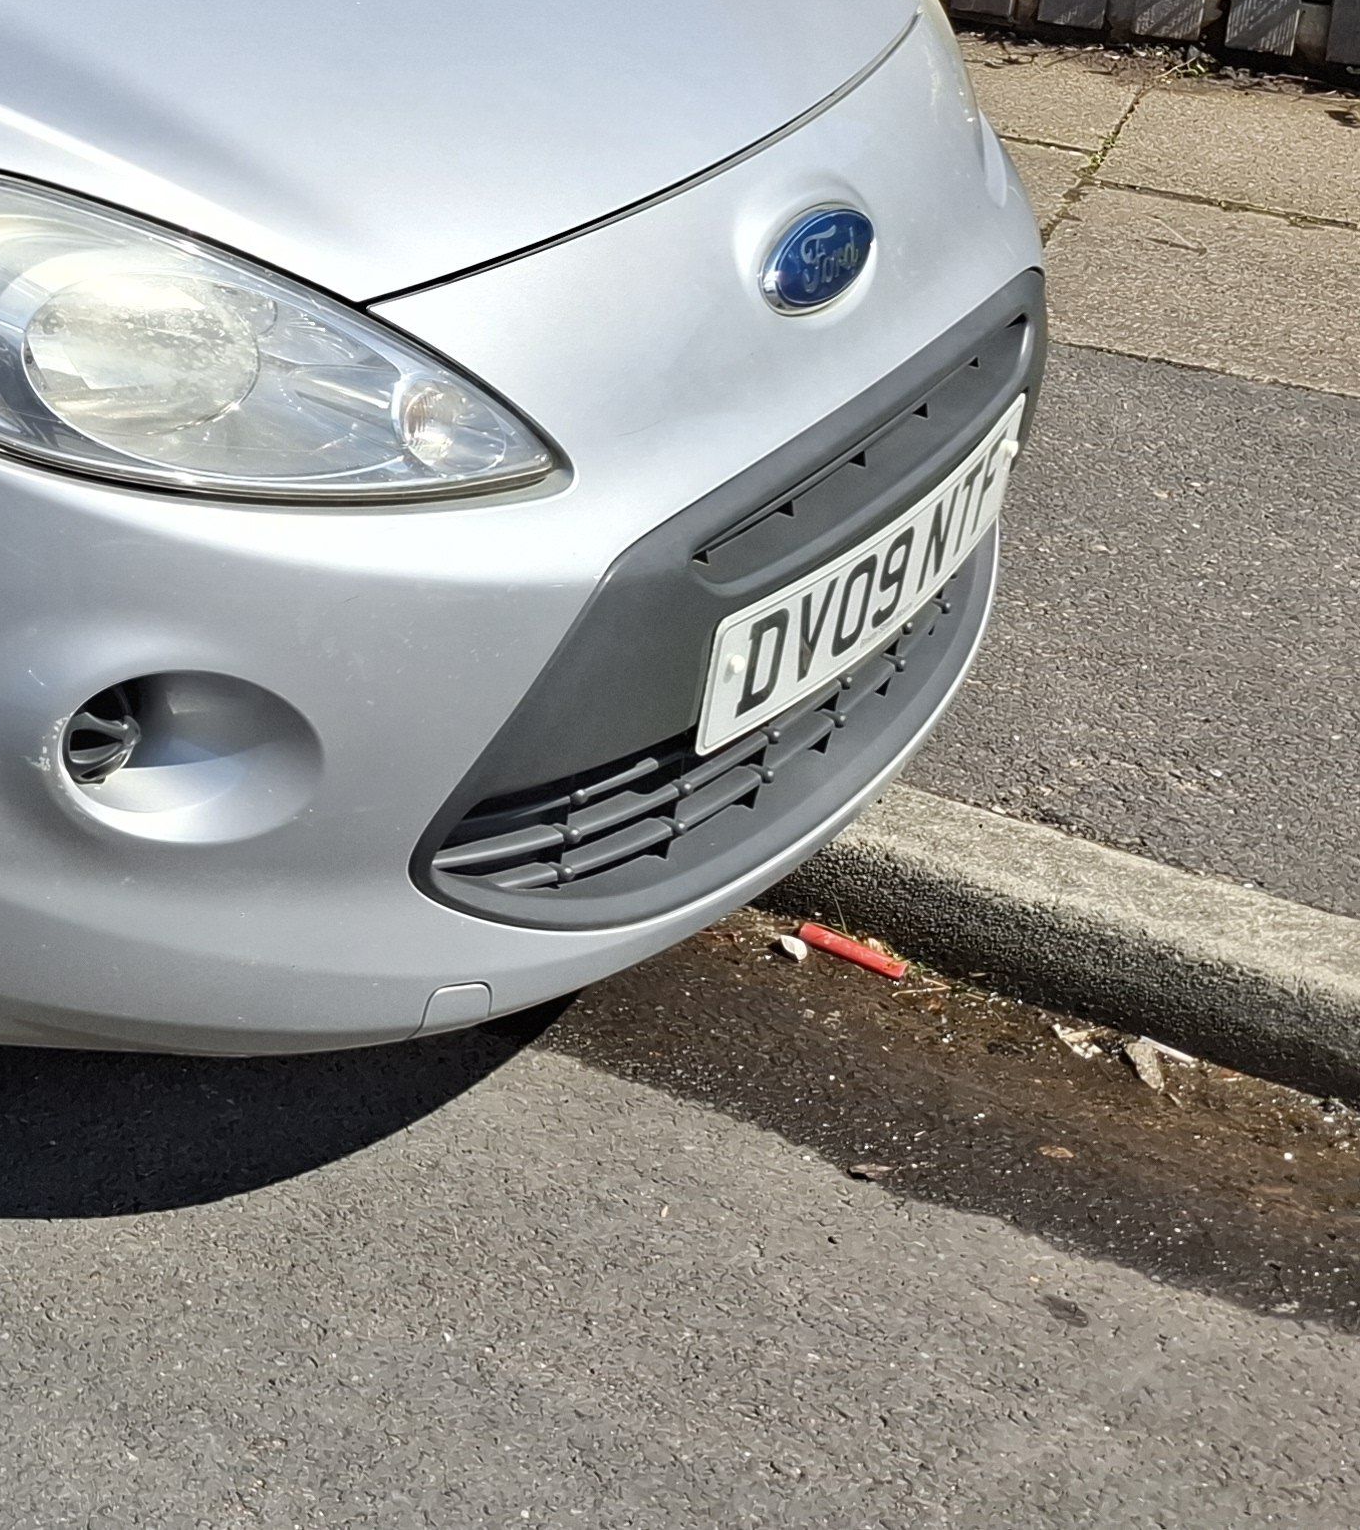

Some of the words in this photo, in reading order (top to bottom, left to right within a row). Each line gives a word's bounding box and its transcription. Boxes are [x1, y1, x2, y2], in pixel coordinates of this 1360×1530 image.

[800, 224, 859, 294] Ford
[735, 526, 916, 719] DV09
[916, 427, 1012, 594] NTF
